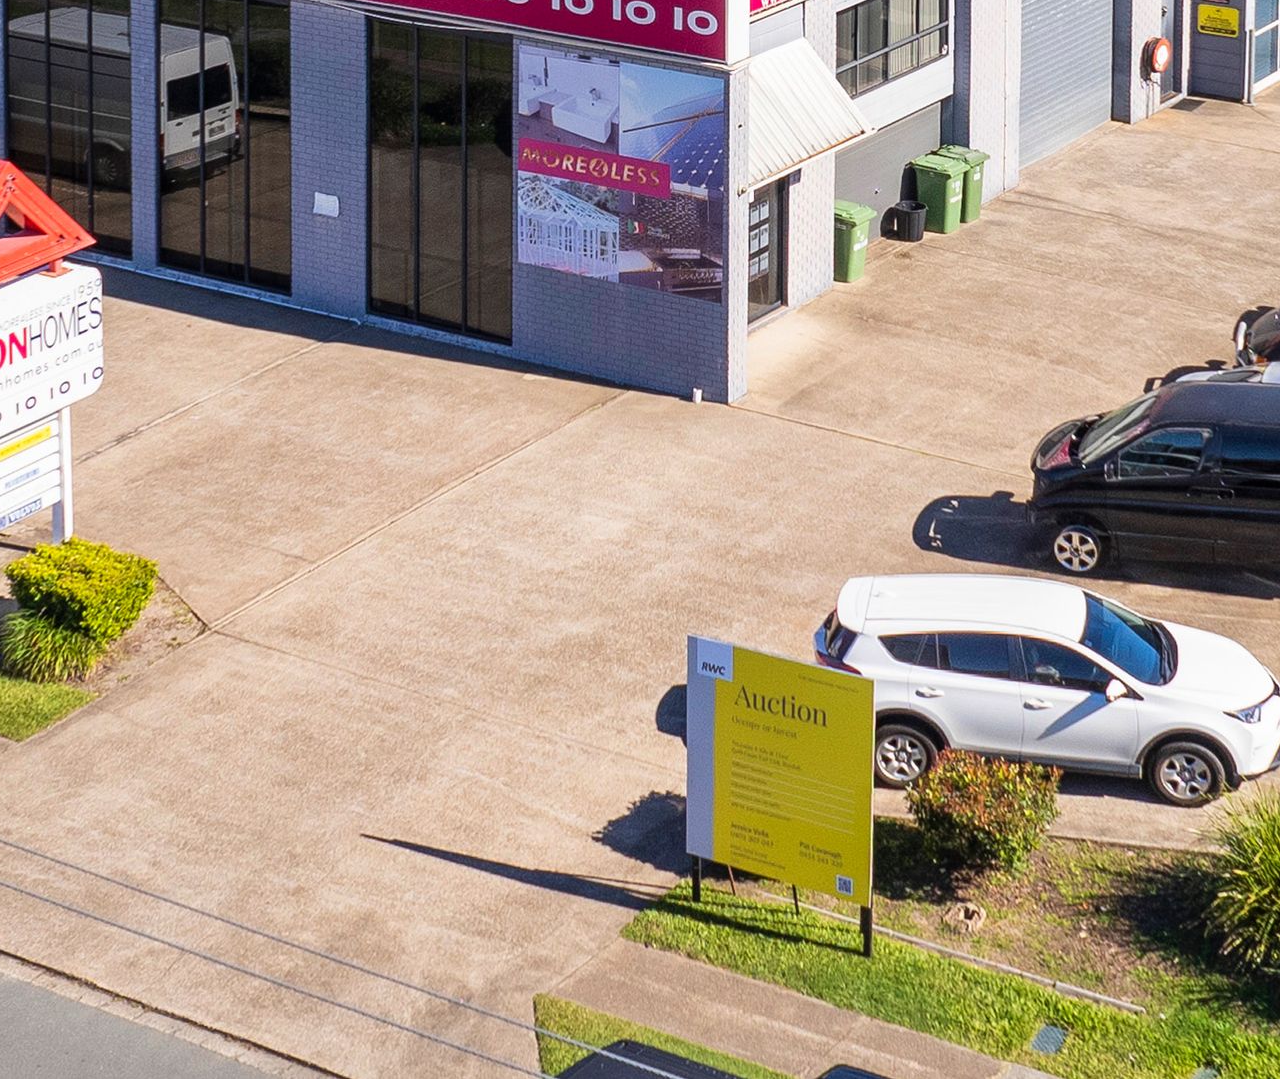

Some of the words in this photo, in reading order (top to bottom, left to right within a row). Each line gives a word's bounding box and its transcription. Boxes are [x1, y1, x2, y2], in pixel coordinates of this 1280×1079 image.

[673, 6, 719, 37] 10
[16, 396, 37, 415] 10
[50, 381, 71, 400] 10
[83, 366, 104, 385] 10
[701, 661, 726, 676] RWC
[733, 684, 828, 728] Auction
